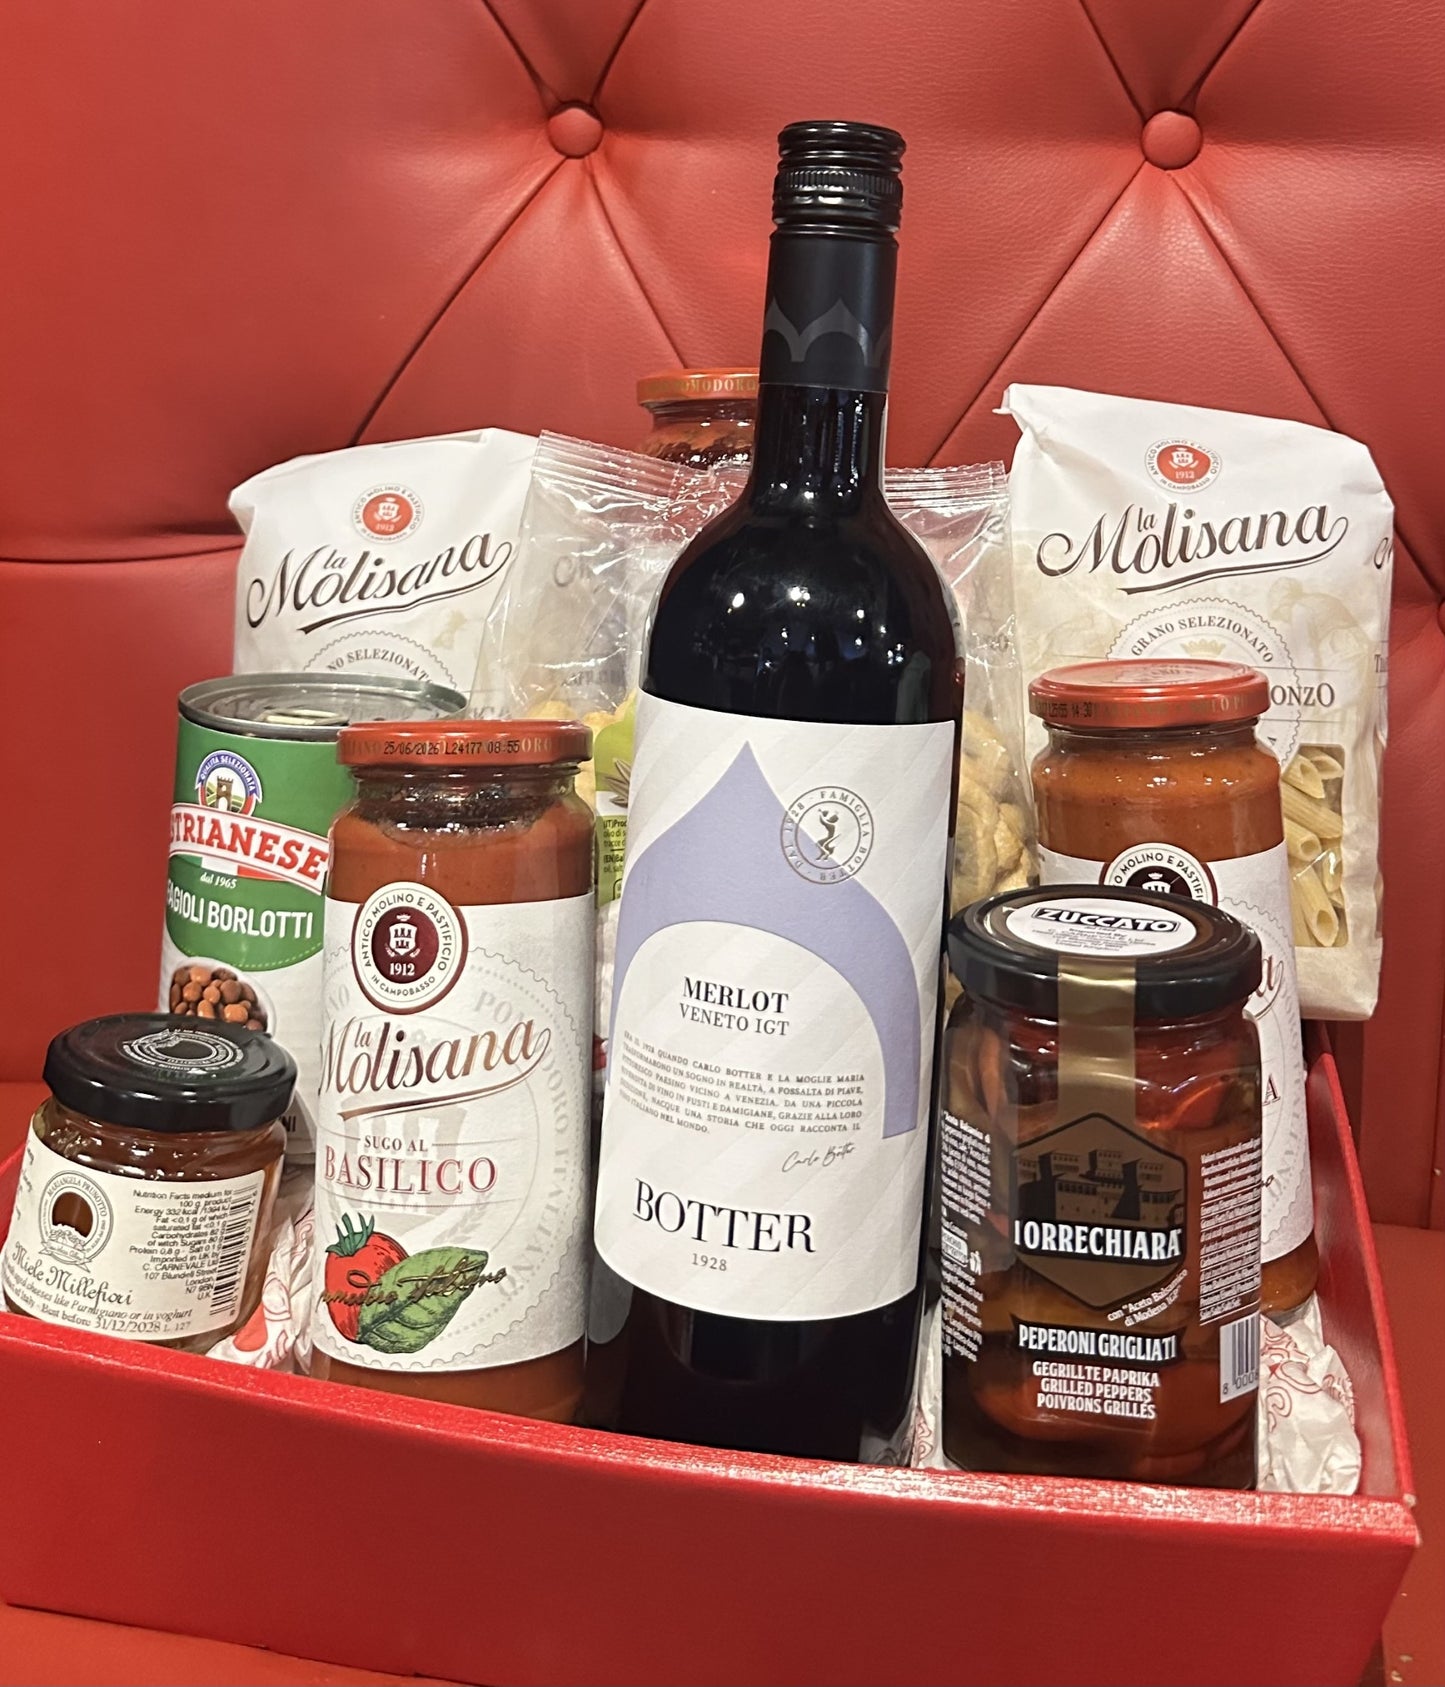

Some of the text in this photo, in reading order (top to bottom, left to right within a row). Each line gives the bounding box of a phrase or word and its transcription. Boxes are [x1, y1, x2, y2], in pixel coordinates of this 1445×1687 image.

[1175, 470, 1195, 479] 1912
[1137, 507, 1157, 532] la
[1037, 503, 1349, 577] Molisana
[323, 549, 347, 569] la
[246, 533, 513, 629] Molisana
[1130, 615, 1274, 663] GRANO SELEZIONATO
[1270, 682, 1335, 708] ONZO
[383, 741, 440, 755] 25/06/2026
[445, 741, 483, 755] L24177
[488, 740, 520, 754] 08:55
[220, 755, 256, 791] SELEZIONATA
[820, 791, 870, 837] FAMIGLIA
[200, 872, 238, 890] dal 1965
[1121, 852, 1204, 898] MOLINO E PASTIFI
[207, 900, 314, 940] BORLOTTI
[361, 893, 452, 971] ANTICO MOLINO E PASTIFICIO
[1038, 909, 1175, 932] ZUCCATO
[390, 963, 415, 976] 1912
[371, 975, 436, 996] IN CAMPOBASSO
[683, 976, 789, 1014] MERLOT
[679, 1003, 790, 1036] VENETO IGT
[354, 1022, 372, 1049] la
[318, 1016, 551, 1097] Molisana
[658, 1049, 689, 1066] QUANDO
[692, 1061, 722, 1074] CARLO
[726, 1068, 762, 1080] BOTTER
[778, 1074, 790, 1082] LA
[837, 1074, 865, 1082] MARIA
[673, 1066, 684, 1078] UN
[686, 1071, 714, 1086] SOGNO
[716, 1078, 726, 1088] IN
[778, 1086, 822, 1096] FOSSALTA
[825, 1088, 834, 1096] DI
[657, 1086, 674, 1099] VINO
[676, 1092, 685, 1102] IN
[686, 1096, 710, 1109] FUSTI
[778, 1112, 812, 1120] GRAZIE
[814, 1112, 838, 1120] ALLA
[840, 1110, 862, 1120] LORO
[690, 1084, 720, 1098] VICINO
[784, 1100, 796, 1108] DA
[802, 1100, 822, 1108] UNA
[826, 1100, 863, 1108] PICCOLA
[652, 1096, 860, 1132] NACQUE UNA STORIA CHE OGGI RACCONTA IL
[660, 1114, 674, 1124] NEL
[363, 1134, 430, 1153] SUGO AL
[323, 1143, 498, 1196] BASILICO
[781, 1149, 821, 1173] Carlo
[82, 1181, 108, 1217] PRUNOTTO
[133, 1190, 168, 1200] Nutrition
[170, 1192, 190, 1200] Facts
[192, 1190, 222, 1200] medium
[134, 1206, 164, 1216] Energy
[166, 1208, 180, 1216] 332
[632, 1178, 817, 1253] BOTTER
[152, 1230, 208, 1240] Carbohydrates
[181, 1237, 207, 1248] Sugars
[150, 1255, 188, 1265] Imported
[154, 1262, 206, 1271] CARNEVALE
[692, 1252, 728, 1272] 1928
[12, 1241, 43, 1281] Miele
[45, 1266, 133, 1311] Millefiori
[144, 1270, 194, 1280] 107 Blundell
[186, 1286, 196, 1294] N7
[70, 1300, 128, 1322] Parmigiano
[130, 1312, 140, 1320] or
[156, 1308, 193, 1323] yoghurt
[1107, 1308, 1125, 1322] con
[1134, 1303, 1169, 1324] Modena
[94, 1317, 162, 1333] 31/12/2028
[1018, 1324, 1176, 1362] PEPERONI GRIGLIATI
[1032, 1361, 1161, 1387] GEGRILLTE PAPRIKA
[1040, 1378, 1152, 1402] GRILLED PEPPERS
[1222, 1382, 1229, 1395] 8
[1036, 1393, 1157, 1420] POIVRONS GRILLÉS
